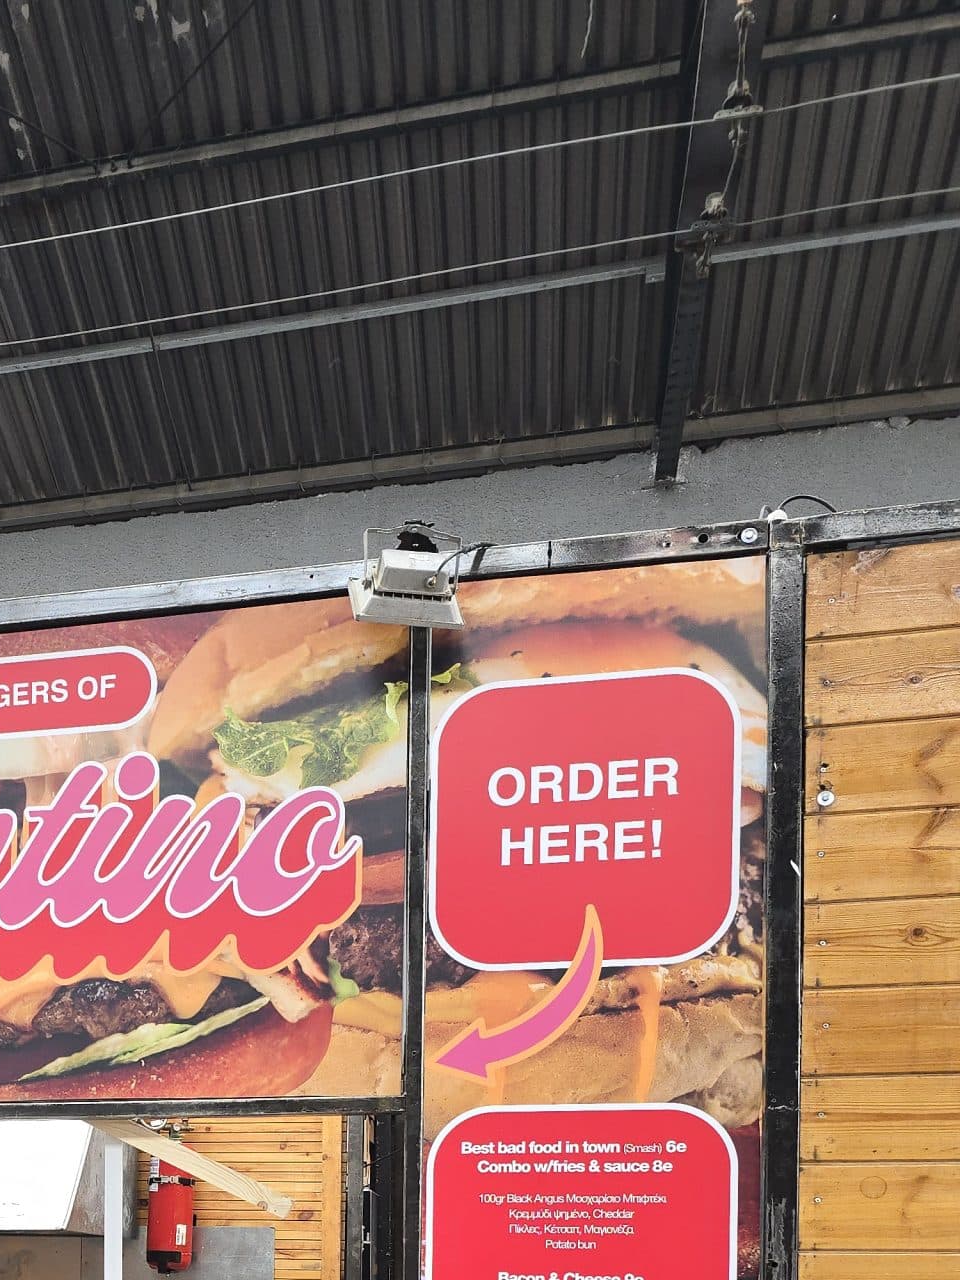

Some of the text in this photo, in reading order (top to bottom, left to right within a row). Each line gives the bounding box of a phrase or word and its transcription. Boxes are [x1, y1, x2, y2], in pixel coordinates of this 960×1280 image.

[76, 673, 117, 701] OF
[487, 756, 680, 807] ORDER
[500, 819, 663, 866] HERE!
[460, 1140, 687, 1155] Best bad food in town (Smash) 6e
[477, 1159, 673, 1173] Combo w/fries & sauce 8e
[478, 1193, 506, 1206] 100gr
[506, 1193, 533, 1204] Black
[534, 1193, 565, 1206] Angus
[592, 1208, 635, 1219] Cheddar
[545, 1239, 596, 1250] Potato bun
